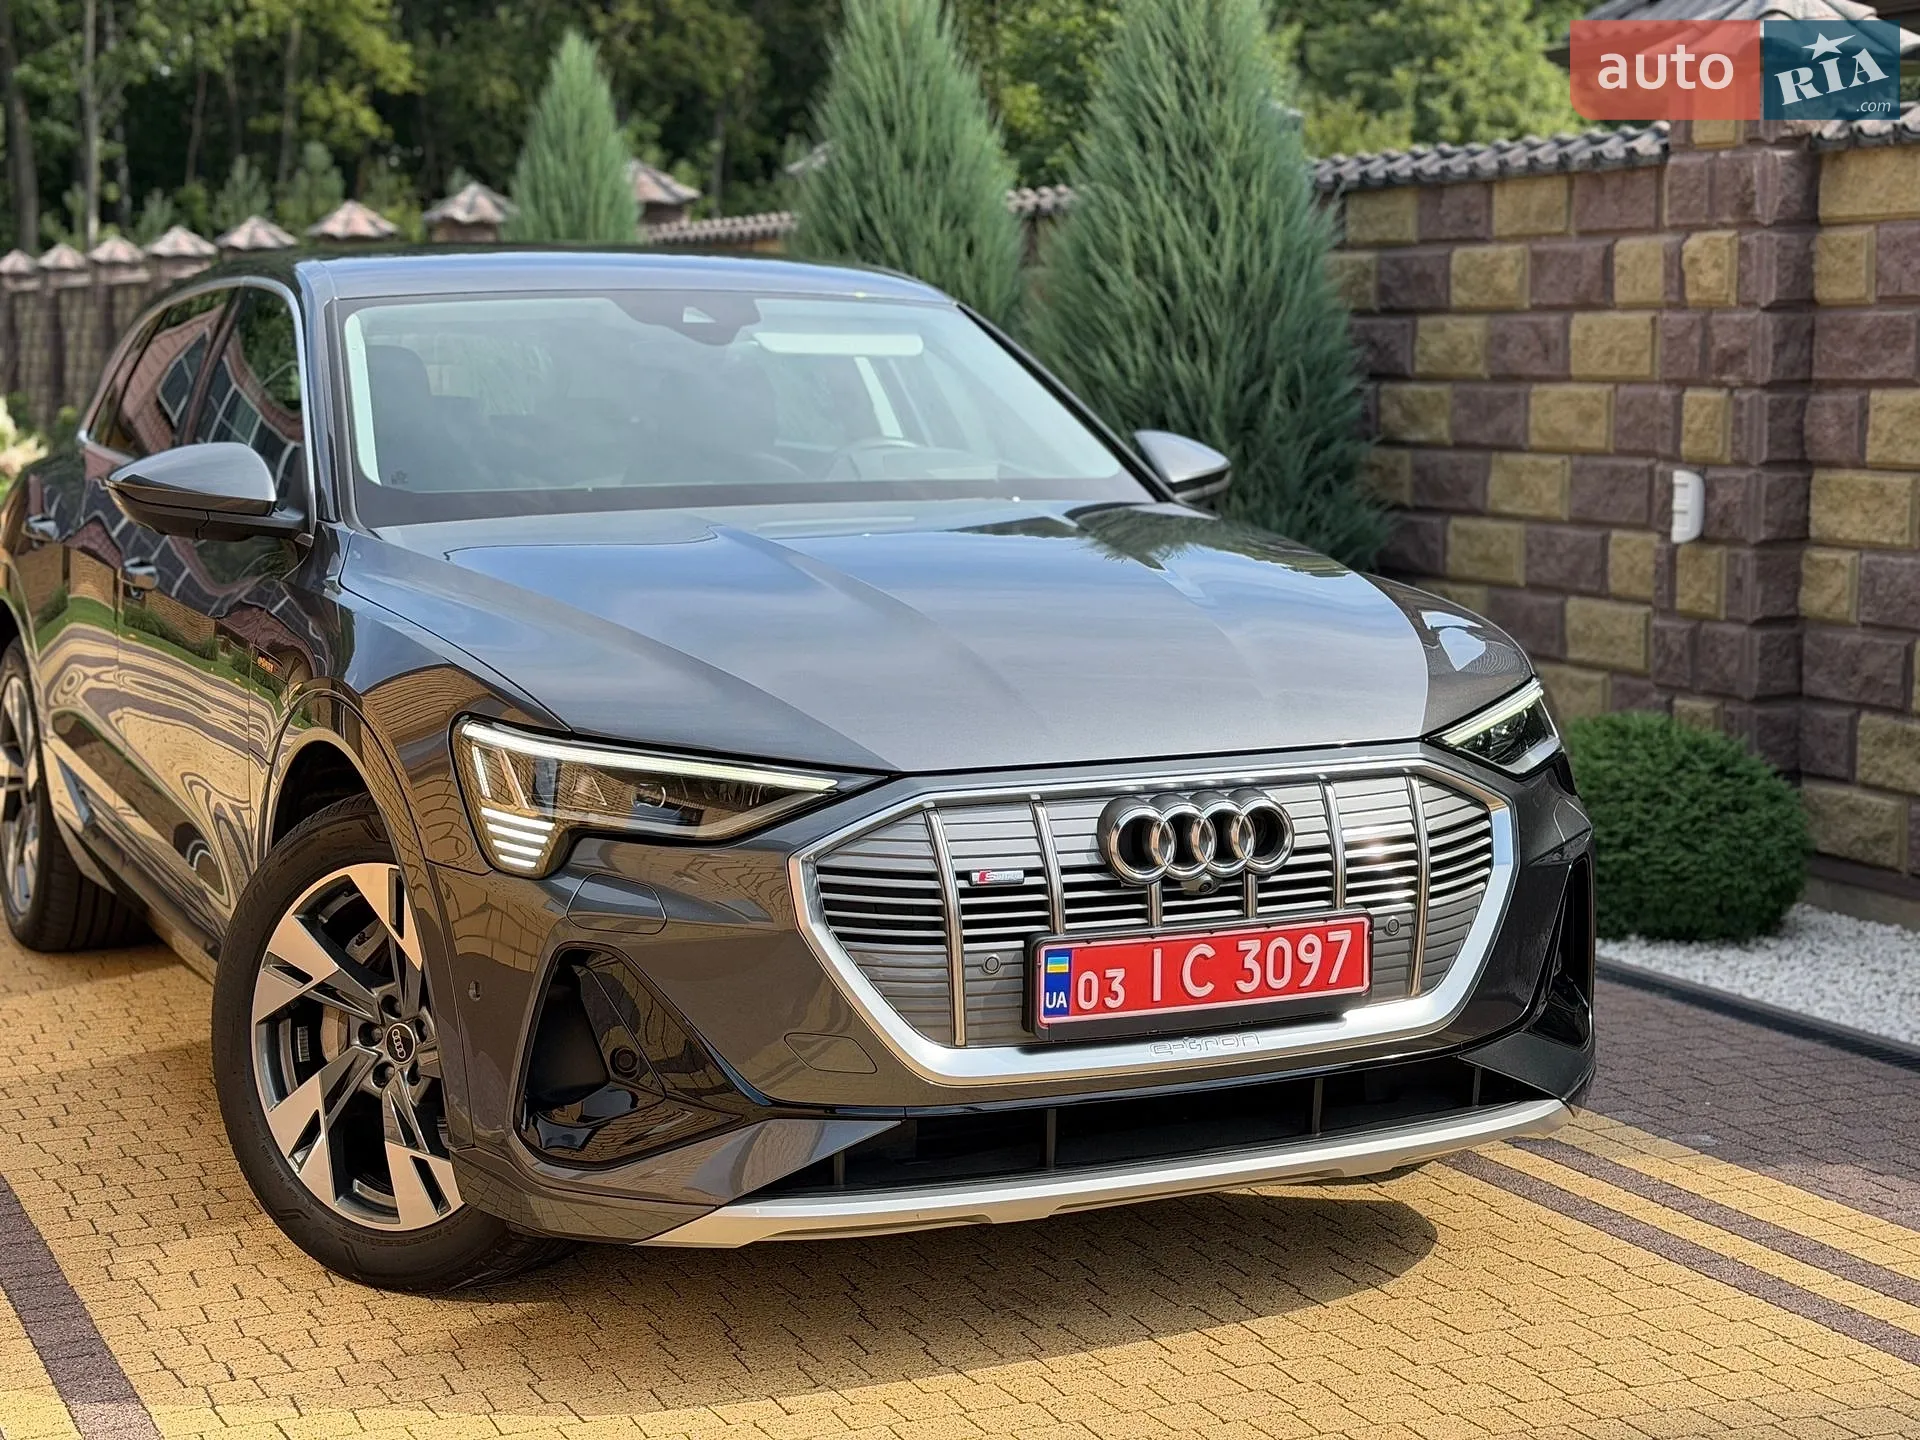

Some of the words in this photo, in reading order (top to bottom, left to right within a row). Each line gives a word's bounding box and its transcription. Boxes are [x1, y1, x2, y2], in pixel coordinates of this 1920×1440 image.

[1077, 968, 1126, 1010] 03
[1235, 929, 1352, 994] 3097
[1046, 991, 1067, 1009] UA
